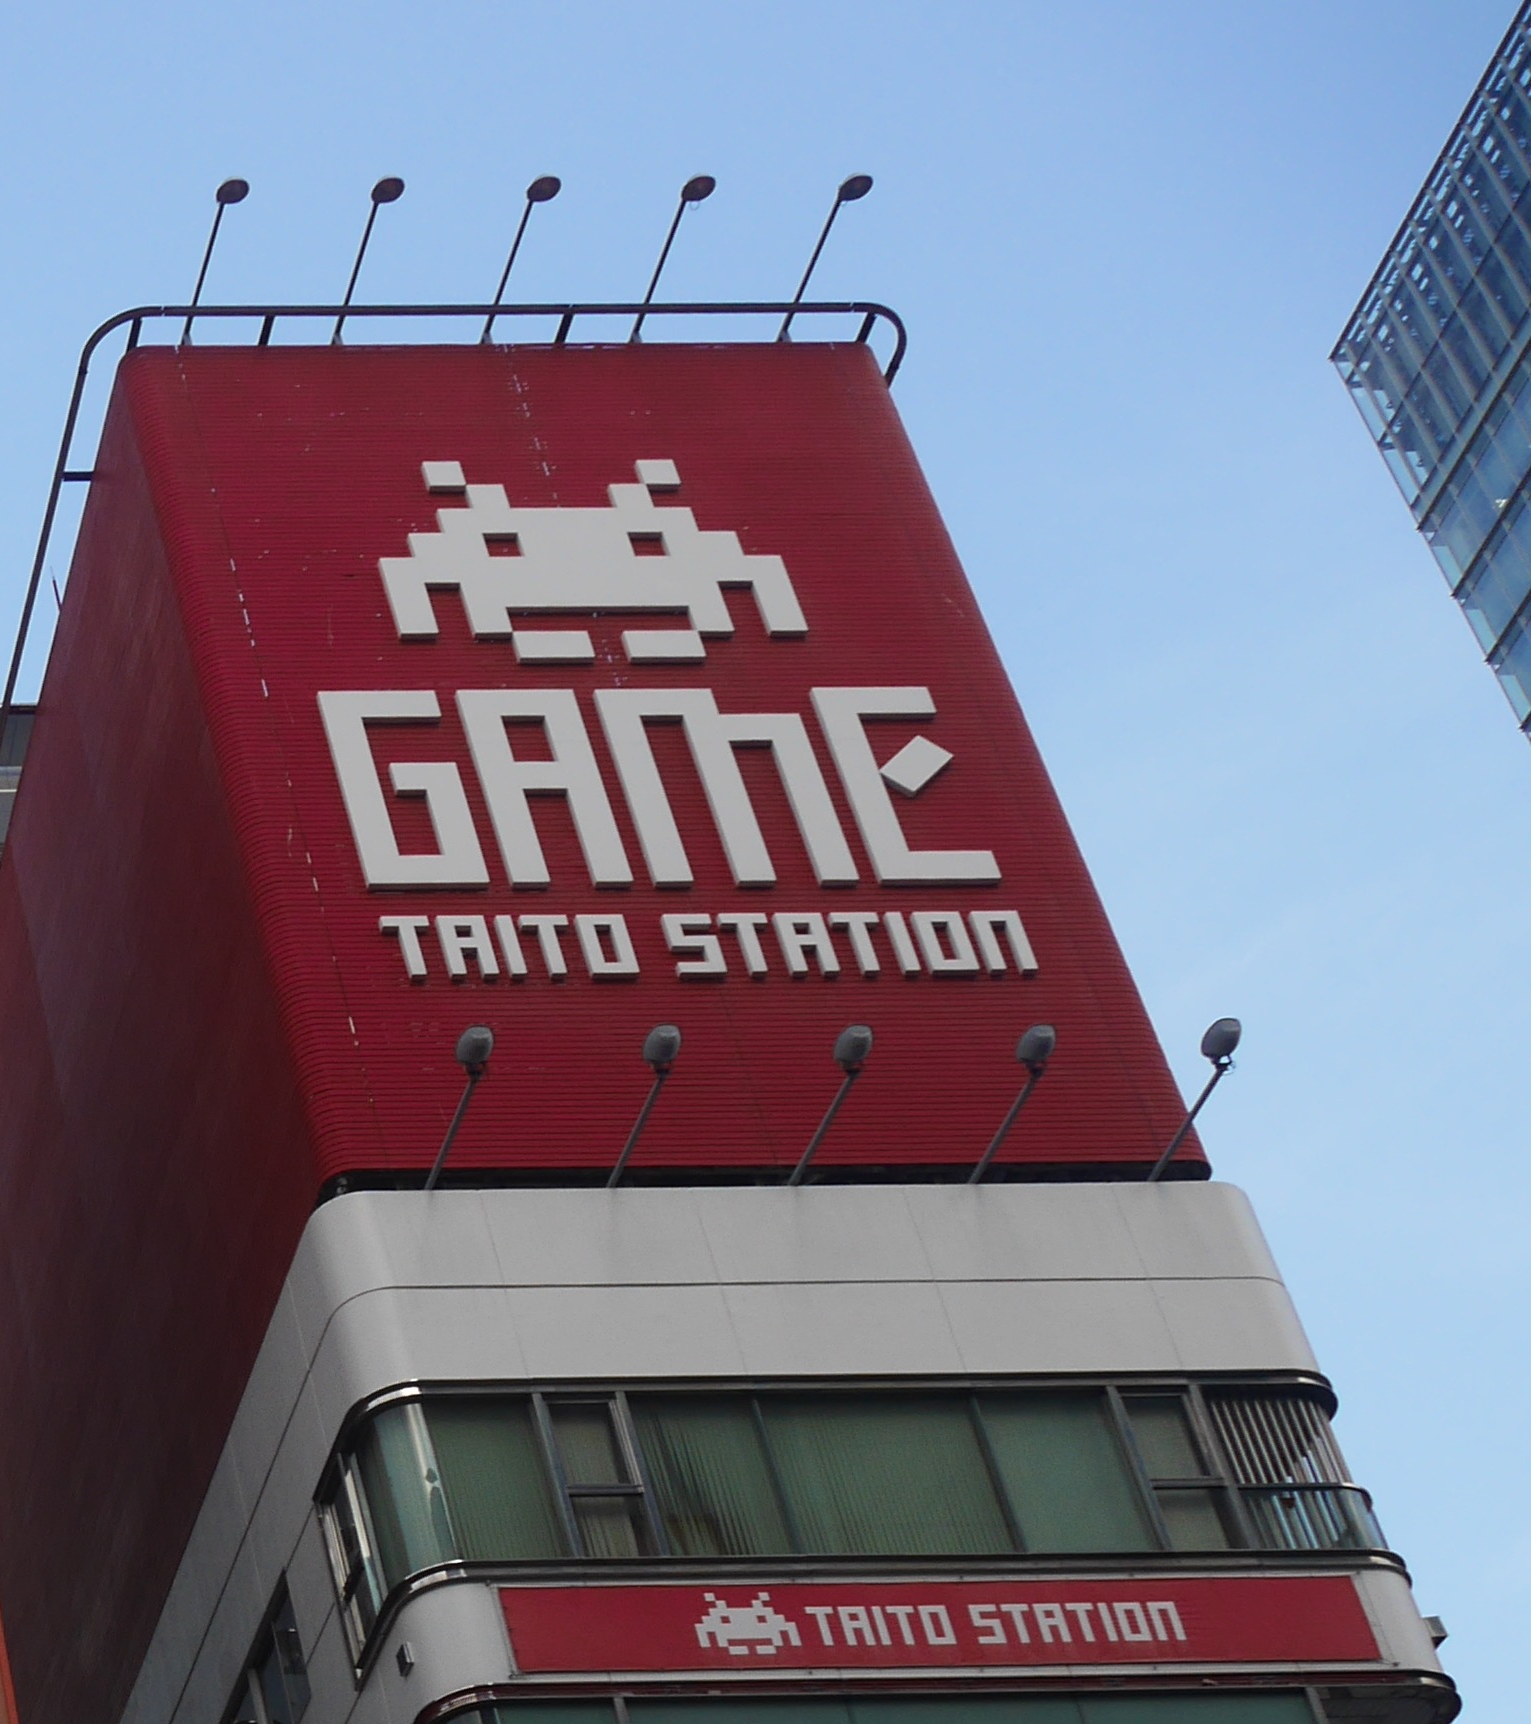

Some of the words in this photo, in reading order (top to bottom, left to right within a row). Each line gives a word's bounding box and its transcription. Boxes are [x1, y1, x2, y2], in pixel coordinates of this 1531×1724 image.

[316, 686, 1002, 890] GAME
[378, 912, 640, 983] TAITO
[661, 910, 1039, 980] STATION
[805, 1605, 958, 1648] TAITO
[968, 1600, 1187, 1646] STATION
